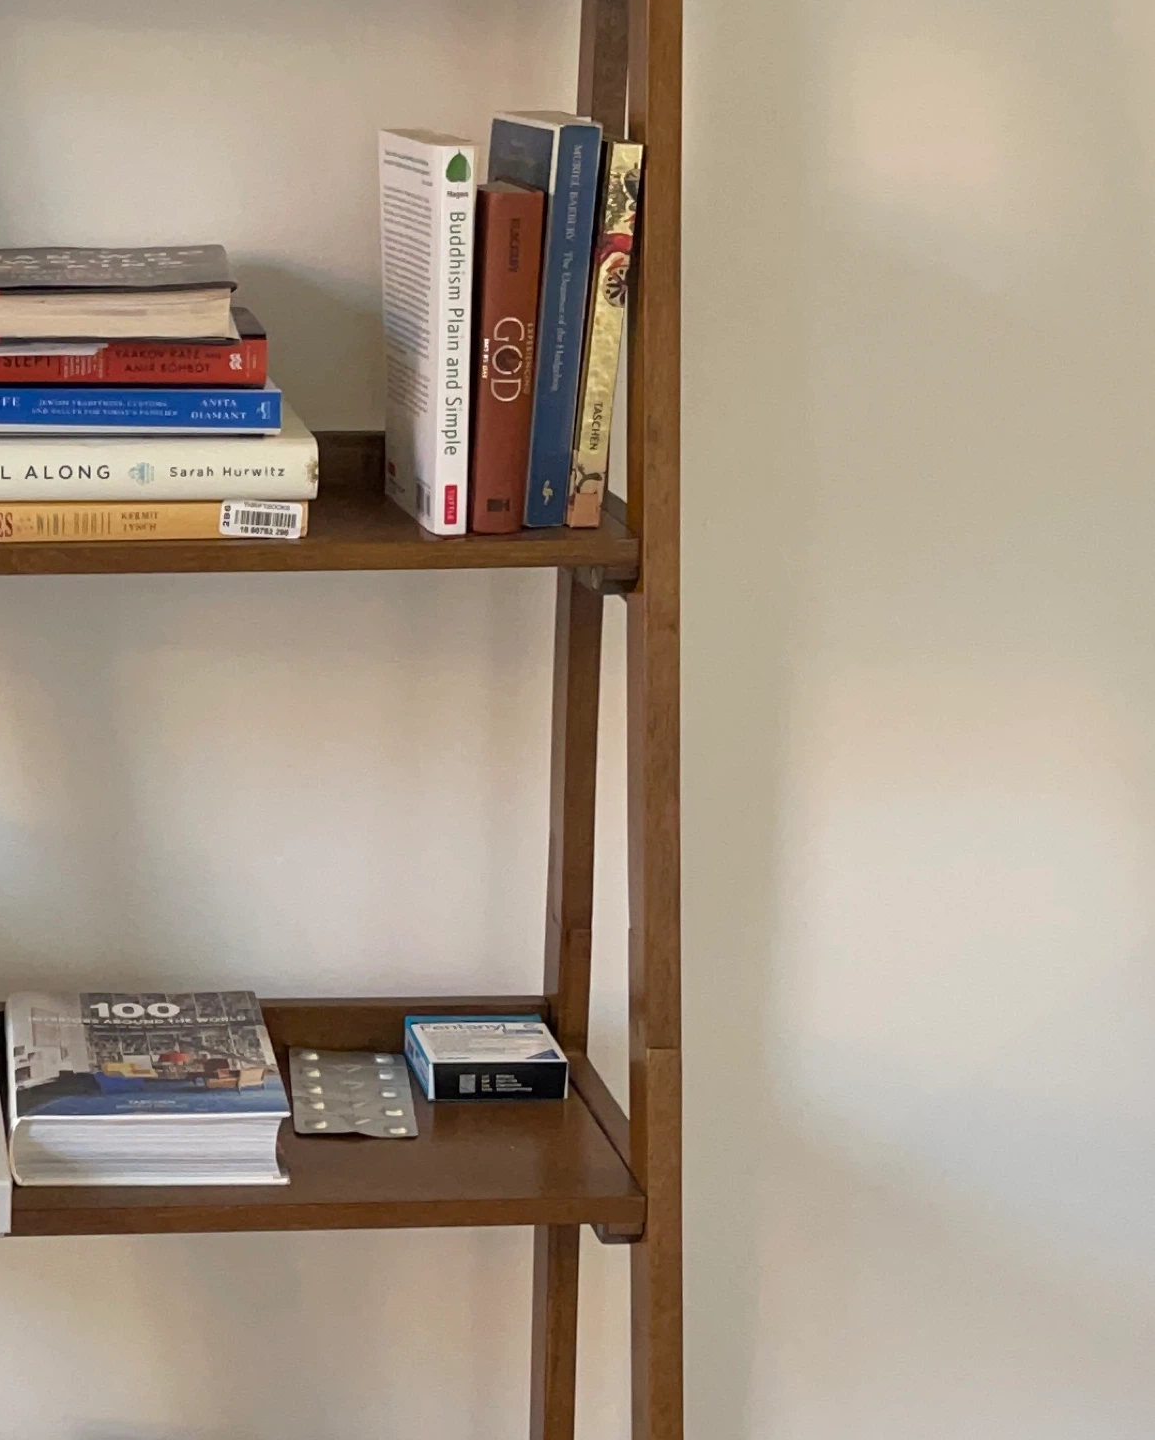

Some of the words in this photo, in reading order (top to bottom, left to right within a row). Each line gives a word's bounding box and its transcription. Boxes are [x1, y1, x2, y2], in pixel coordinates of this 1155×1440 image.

[448, 211, 466, 300] Buddhism
[447, 308, 465, 350] Plain
[490, 317, 526, 402] GOD
[446, 357, 462, 390] and
[201, 398, 237, 408] ANITA
[191, 410, 247, 420] DIAMANT
[441, 397, 463, 455] Simple
[589, 402, 604, 451] TASCHEN
[25, 465, 110, 480] ALONG
[169, 466, 214, 478] Sarah
[223, 466, 286, 478] Hurwitz
[121, 511, 159, 521] KERMIT
[89, 1002, 181, 1019] 100
[169, 1017, 192, 1025] THE
[195, 1015, 247, 1023] WORLD
